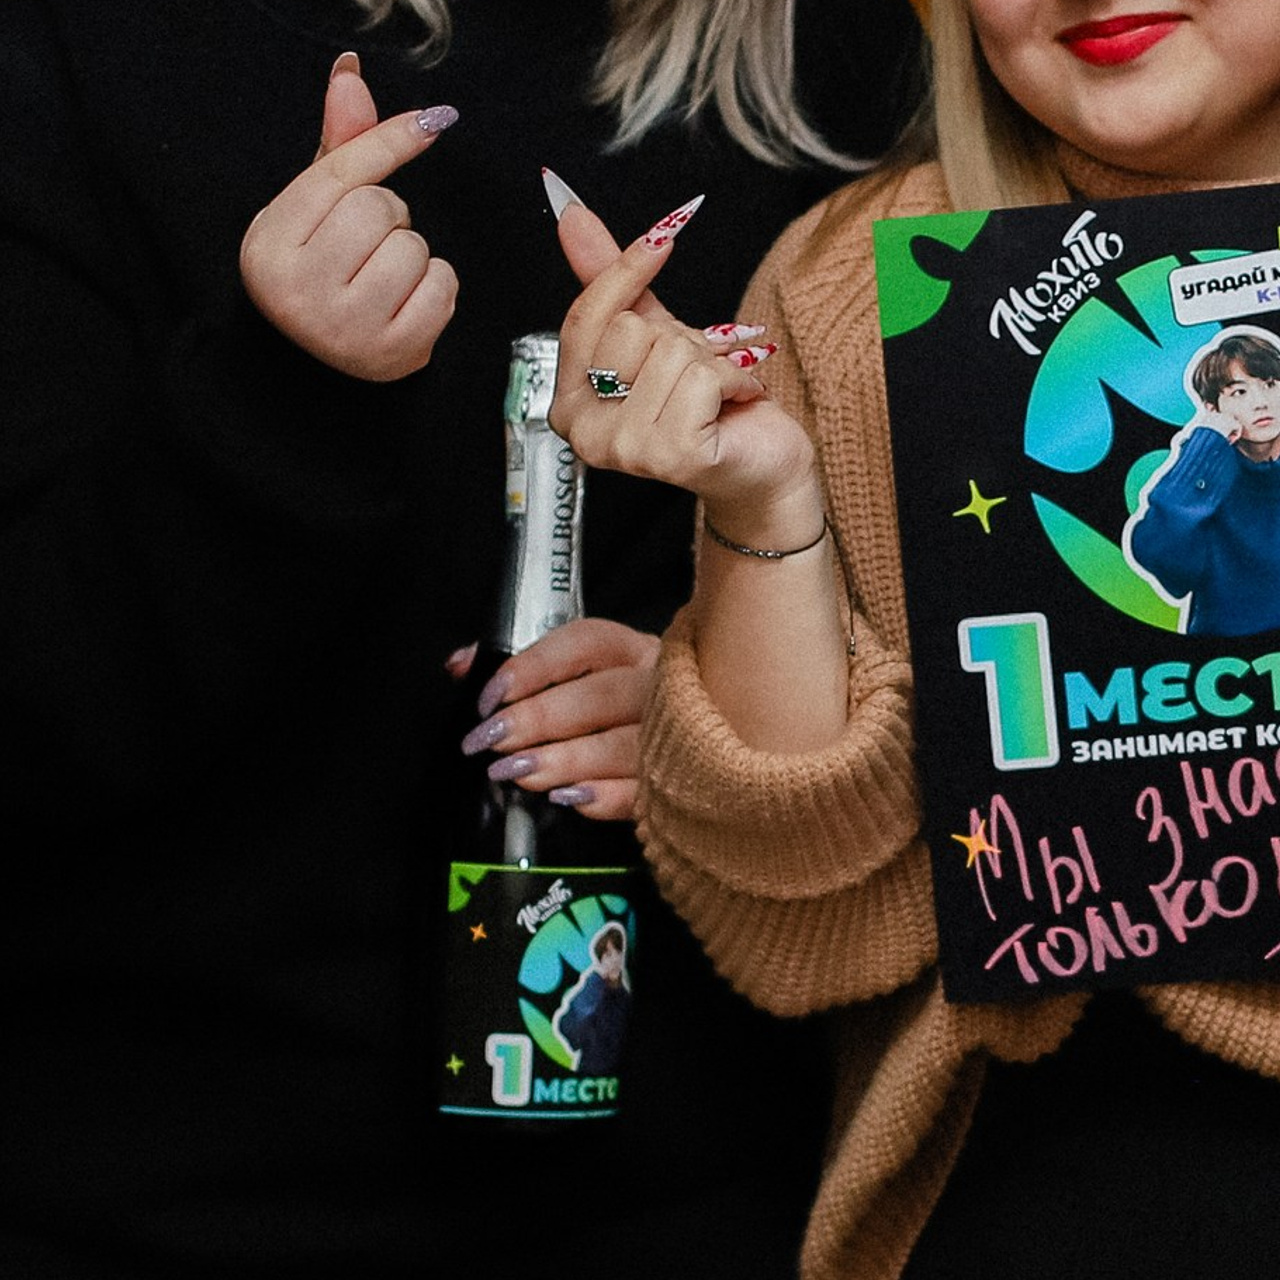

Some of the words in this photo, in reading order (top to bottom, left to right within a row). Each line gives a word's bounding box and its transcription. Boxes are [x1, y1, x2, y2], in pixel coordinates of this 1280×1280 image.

[1047, 272, 1101, 324] КВИЗ
[1180, 267, 1266, 300] УГАДАЙ
[958, 612, 1060, 771] 1
[1071, 726, 1248, 763] ЗАНИМАЕТ
[485, 1033, 533, 1107] 1
